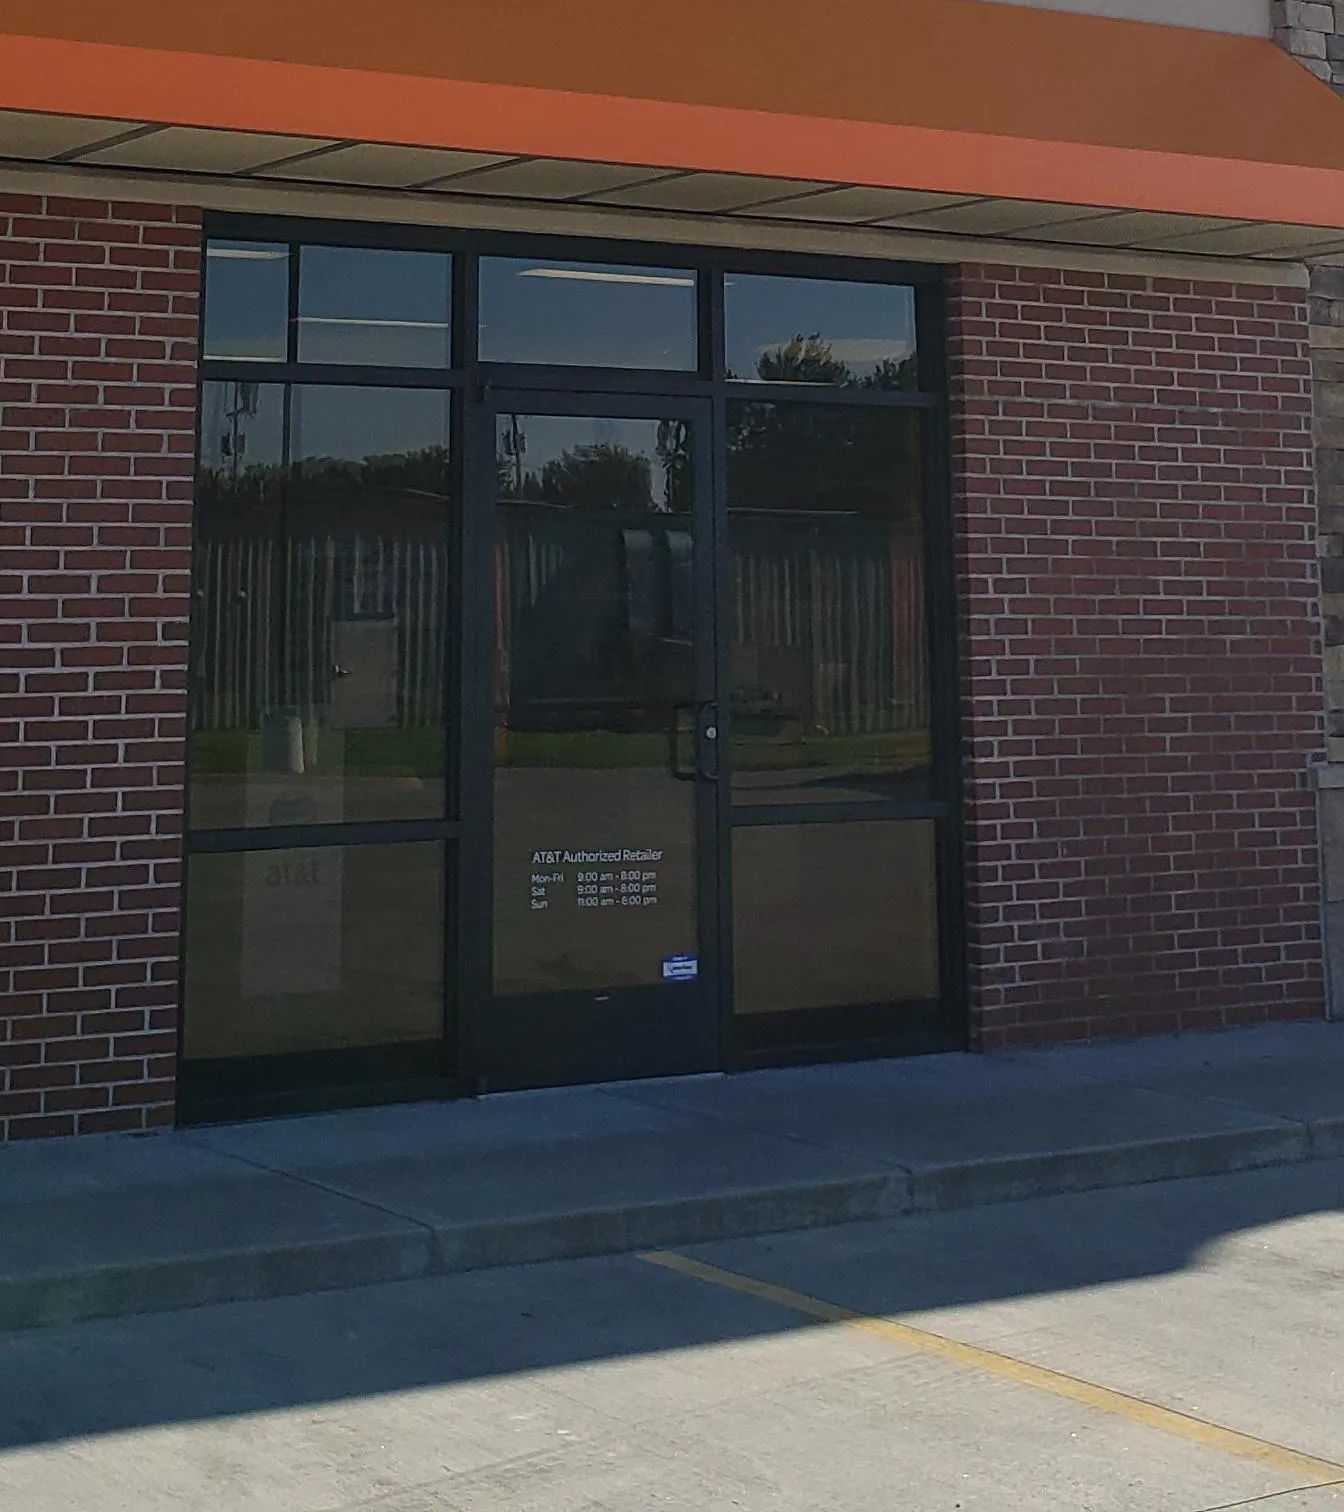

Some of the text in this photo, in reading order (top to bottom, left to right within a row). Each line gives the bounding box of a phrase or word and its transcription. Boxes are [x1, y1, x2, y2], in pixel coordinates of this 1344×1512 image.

[532, 848, 663, 864] AT&T Authorized Retailer
[531, 872, 564, 883] Mon-Fri
[599, 873, 614, 881] am
[642, 871, 657, 882] pm
[531, 886, 546, 897] Sat
[599, 885, 614, 894] am
[642, 884, 657, 894] pm
[530, 899, 548, 909] Sun
[600, 898, 615, 906] am
[643, 896, 658, 907] pm
